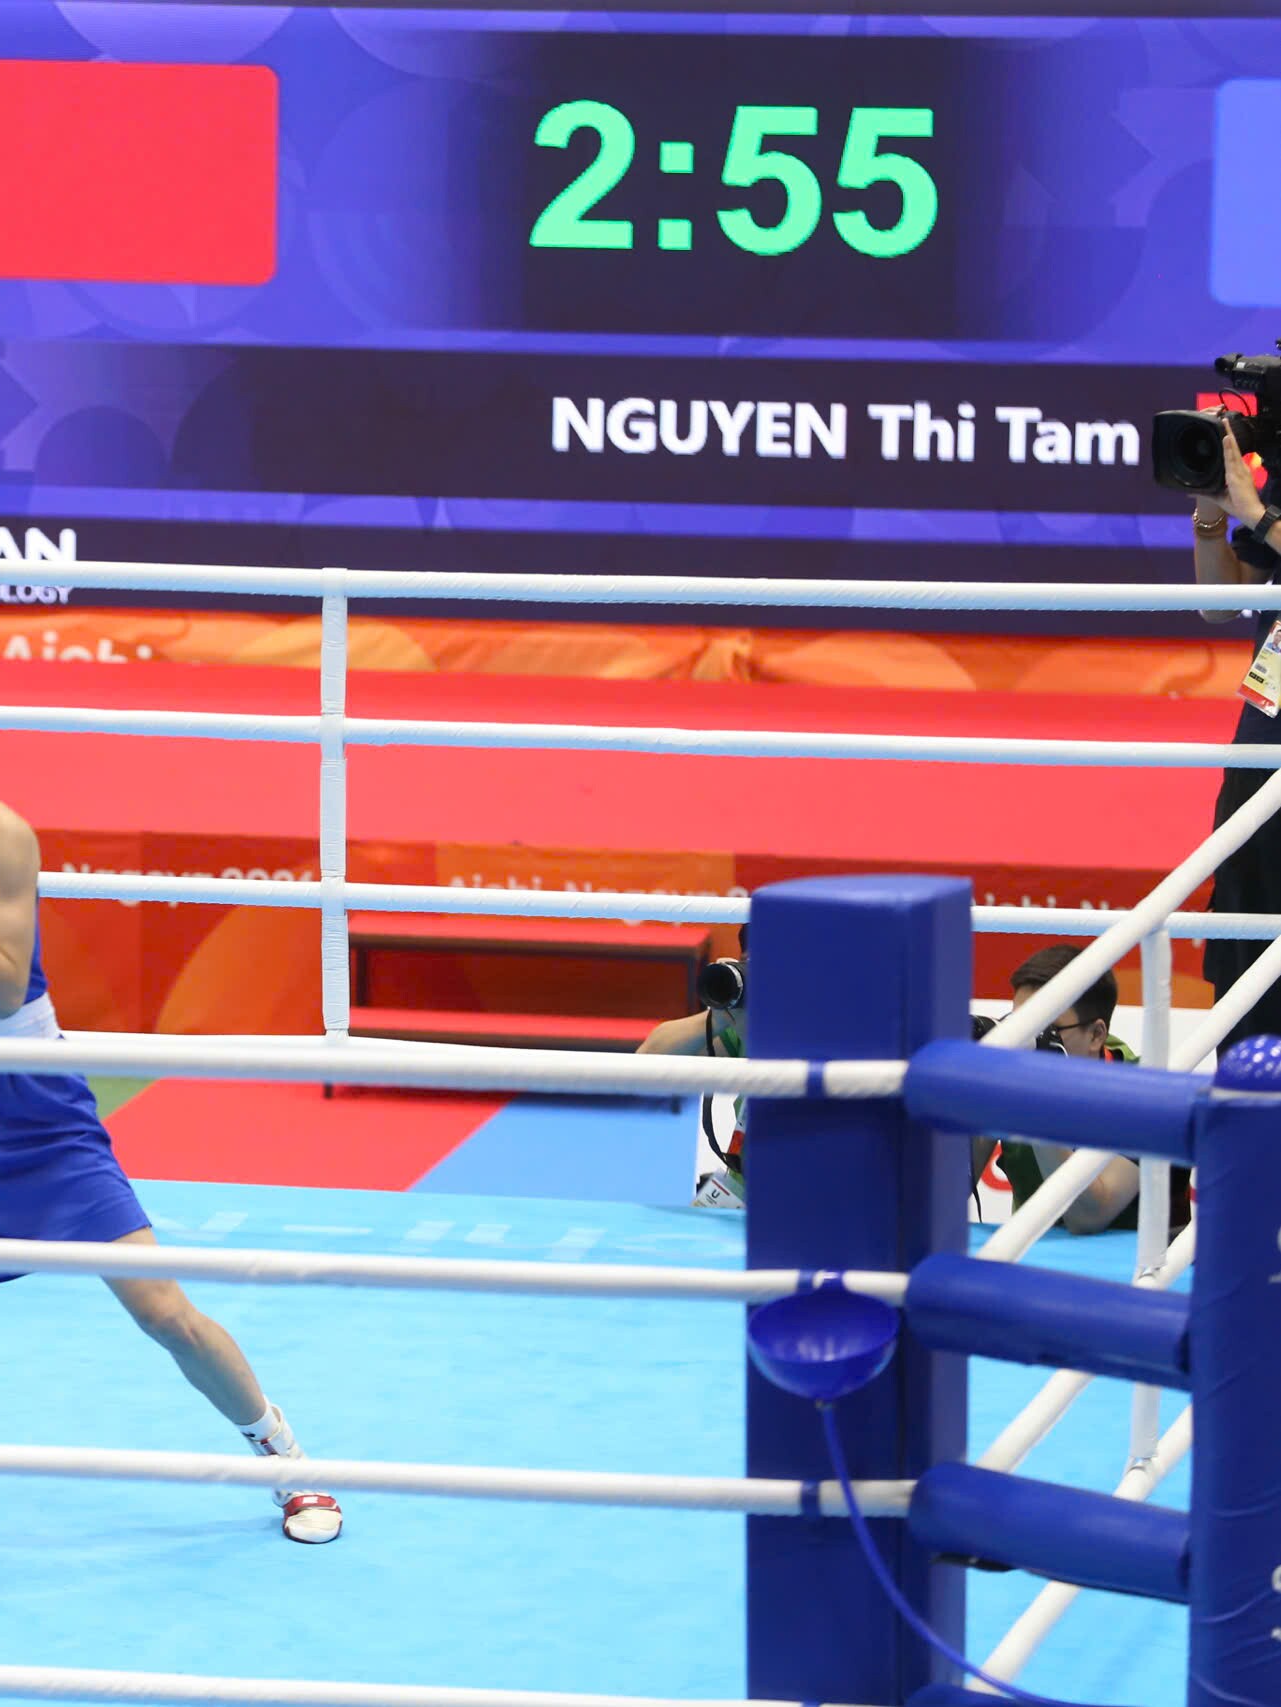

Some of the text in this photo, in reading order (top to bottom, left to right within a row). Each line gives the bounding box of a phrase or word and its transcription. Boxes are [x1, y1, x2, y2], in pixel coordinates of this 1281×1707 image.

[529, 100, 937, 258] 2:55
[552, 398, 1140, 465] NGUYEN Thi Tam
